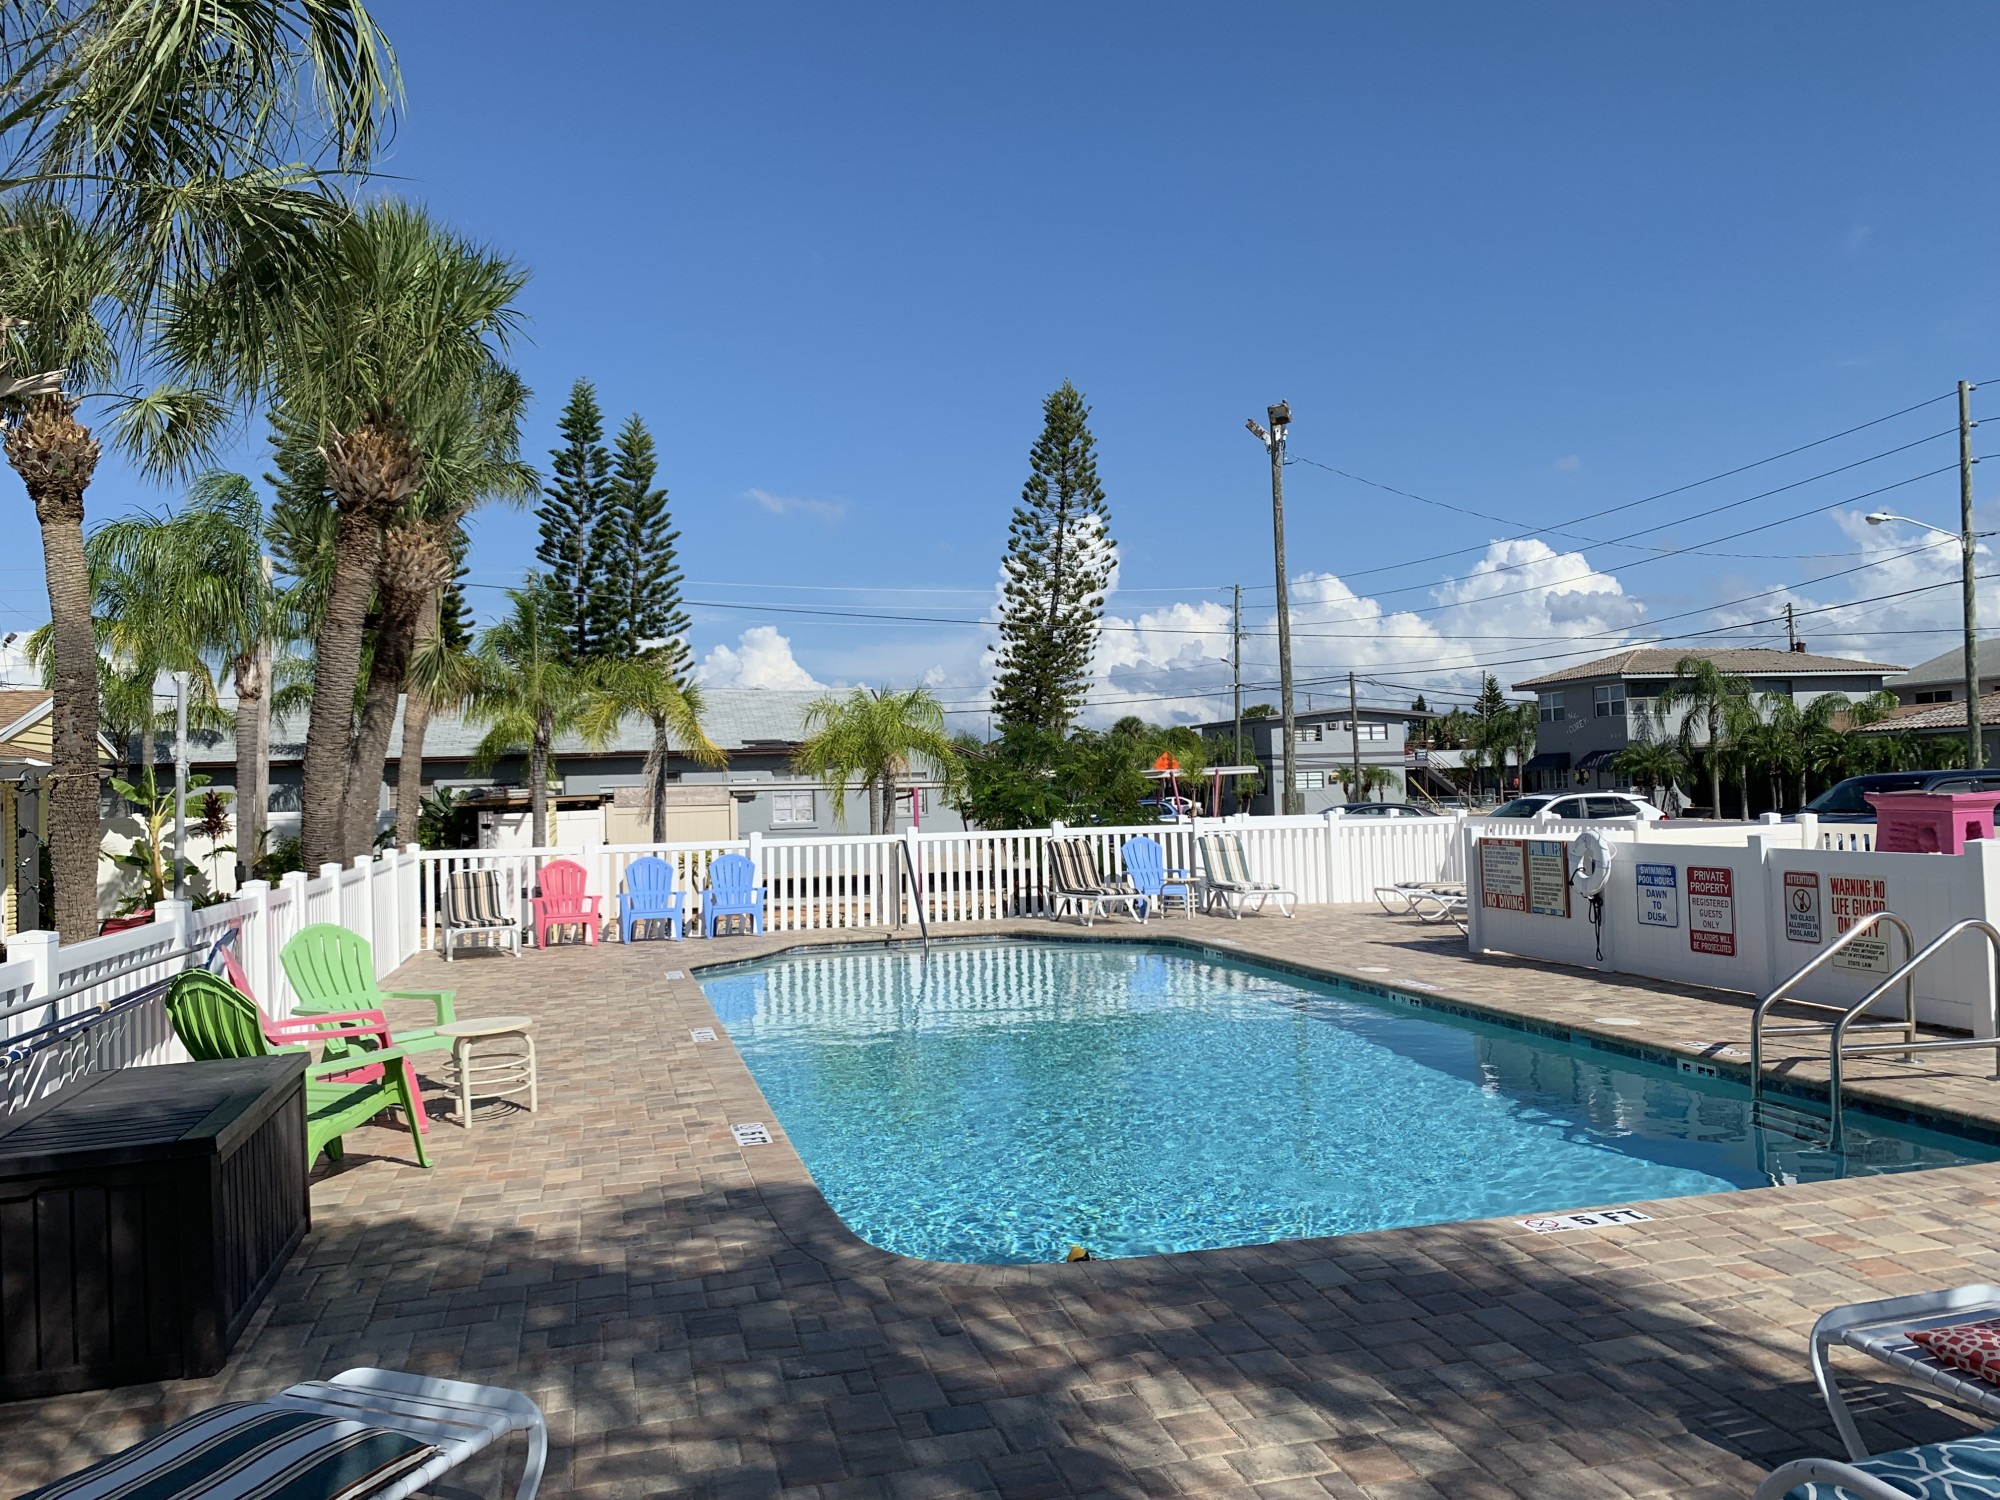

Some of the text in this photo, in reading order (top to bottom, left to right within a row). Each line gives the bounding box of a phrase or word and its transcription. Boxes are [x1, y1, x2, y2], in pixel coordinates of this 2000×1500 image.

[1640, 866, 1672, 876] SWIMMING
[1694, 870, 1725, 882] PRIVATE
[1638, 875, 1675, 886] POOL HOURS
[1786, 875, 1817, 886] ATTENTION
[1690, 882, 1729, 894] PROPERTY
[1874, 880, 1885, 899] NO
[1646, 889, 1667, 899] DAWN
[1487, 892, 1524, 911] NO DIVING
[1652, 900, 1662, 910] TO
[1692, 897, 1729, 908] REGISTERED
[1832, 897, 1886, 917] LIFE GUARD
[1647, 911, 1667, 922] DUSK
[1700, 909, 1723, 919] GUESTS
[1798, 915, 1816, 923] GLASS
[1703, 920, 1720, 930] ONLY
[1789, 922, 1812, 930] ALLOWED
[1838, 916, 1851, 934] ON
[1693, 932, 1731, 944] VIOLATORS WILL
[1790, 929, 1803, 937] POOL
[1693, 941, 1732, 954] BE PROSECUTED
[1569, 1210, 1649, 1226] 5 FT.
